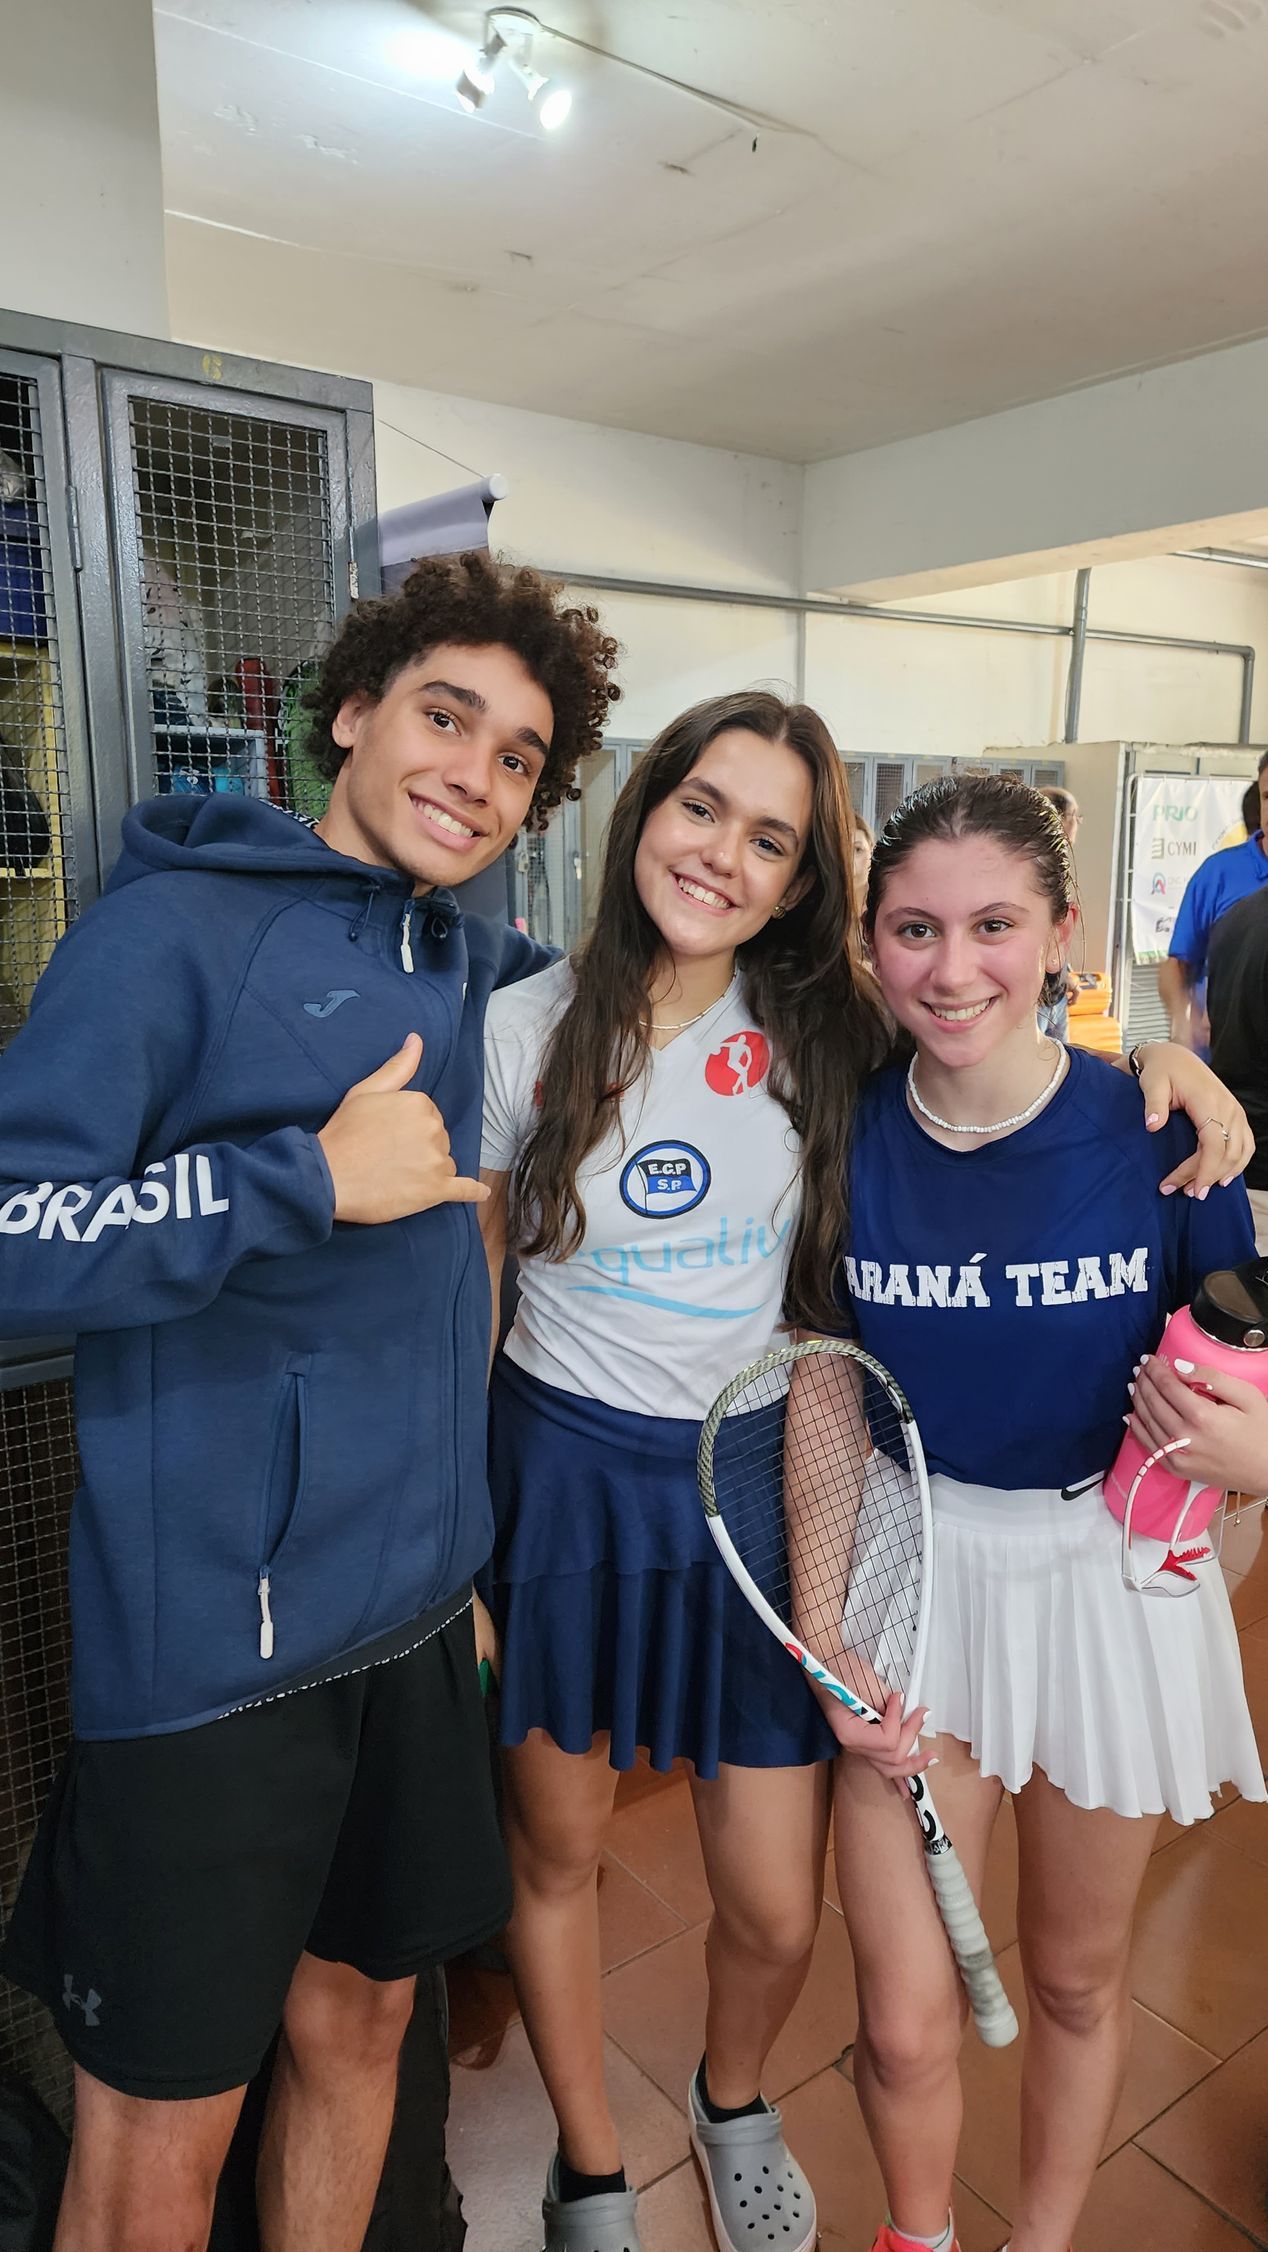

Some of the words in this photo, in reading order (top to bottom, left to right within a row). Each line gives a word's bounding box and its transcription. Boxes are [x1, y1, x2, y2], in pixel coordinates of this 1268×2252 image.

[1152, 804, 1199, 822] PRIO
[1167, 841, 1197, 856] CYMI
[0, 1153, 230, 1242] BRASIL
[577, 1216, 792, 1286] qualiv
[844, 1252, 991, 1308] ARANÁ
[1005, 1247, 1149, 1307] TEAM
